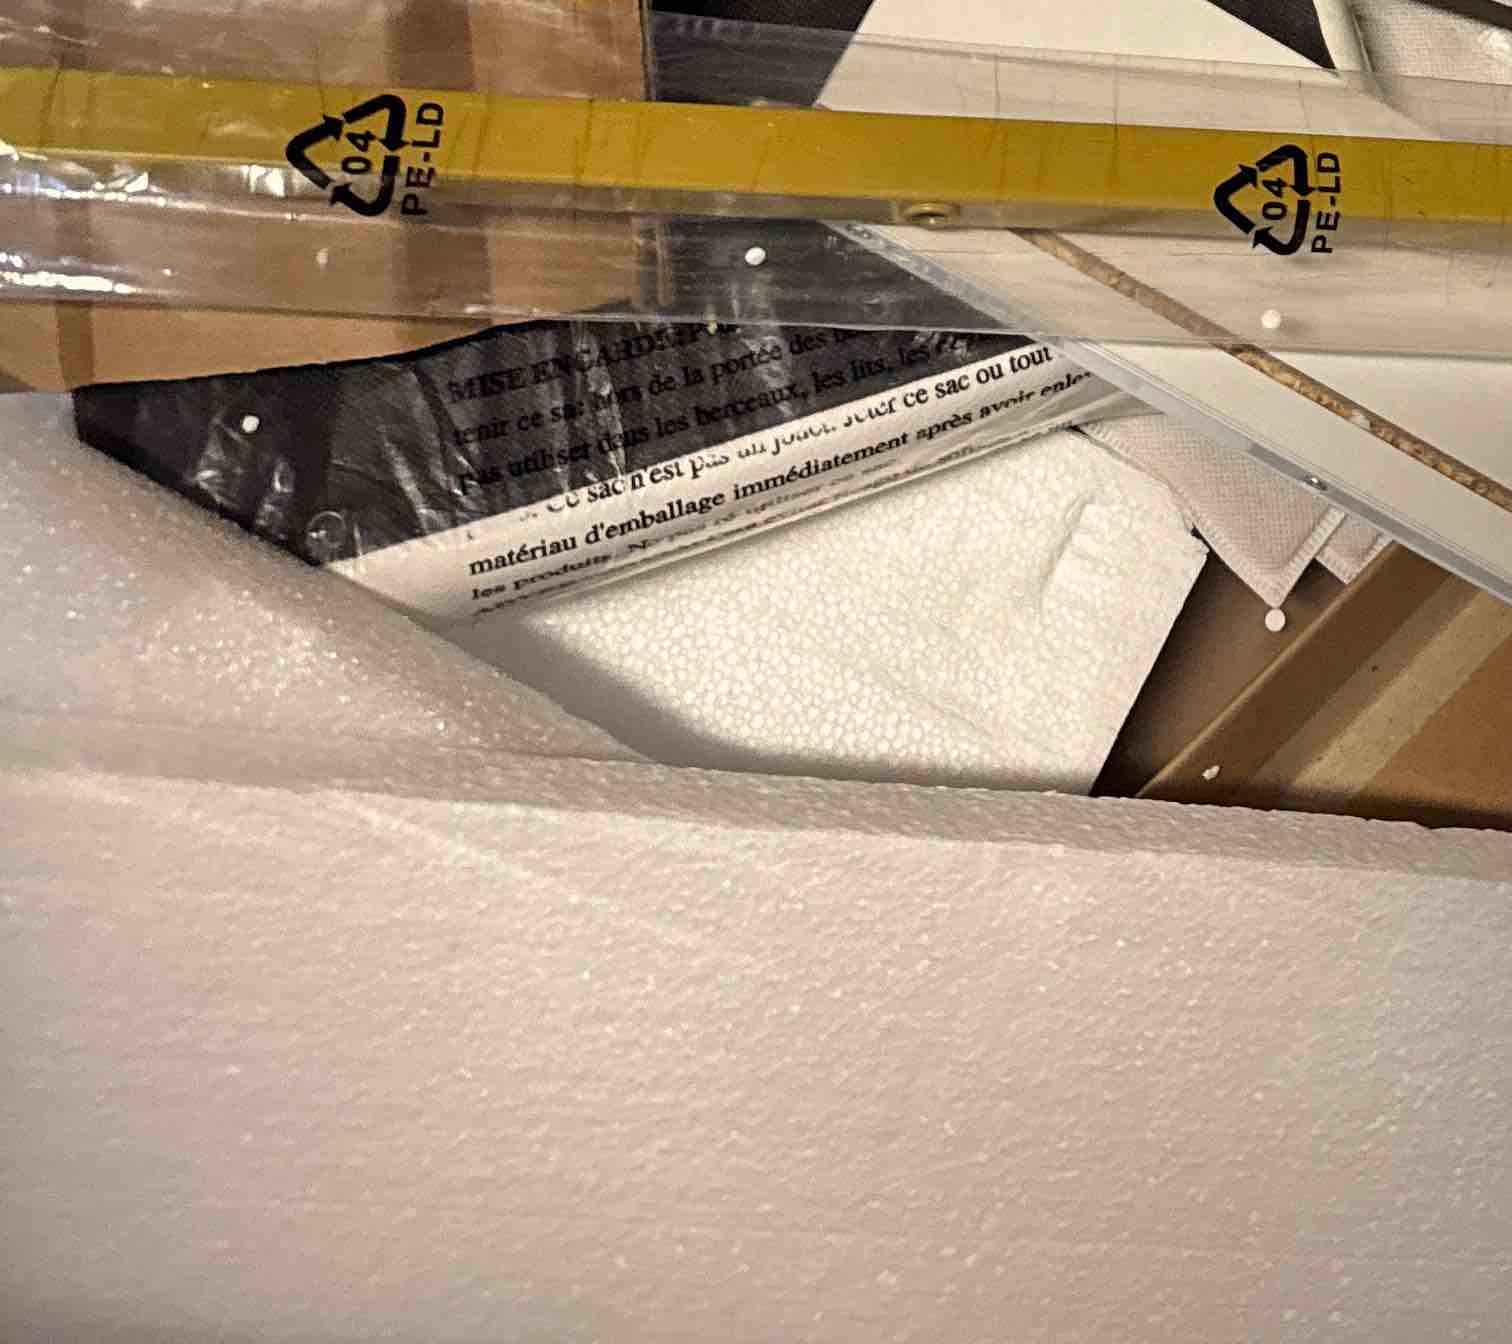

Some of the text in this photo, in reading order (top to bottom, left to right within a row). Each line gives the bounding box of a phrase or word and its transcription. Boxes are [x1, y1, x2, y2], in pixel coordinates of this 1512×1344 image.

[342, 130, 375, 175] 04
[402, 102, 445, 216] PE-LD
[1261, 177, 1288, 221] 04
[1311, 152, 1341, 254] PE-LD
[517, 412, 543, 430] ce
[650, 374, 677, 395] de
[683, 367, 705, 386] la
[587, 479, 626, 503] sac
[631, 461, 686, 491] n'est
[903, 388, 929, 408] ce
[935, 374, 970, 399] sac
[976, 363, 1004, 384] ou
[1009, 346, 1054, 374] tout
[656, 415, 689, 437] les
[468, 535, 578, 576] matériau
[584, 492, 727, 545] d'emballage
[733, 431, 910, 501] immédiatement
[916, 412, 973, 441] après
[979, 389, 1037, 419] avoir
